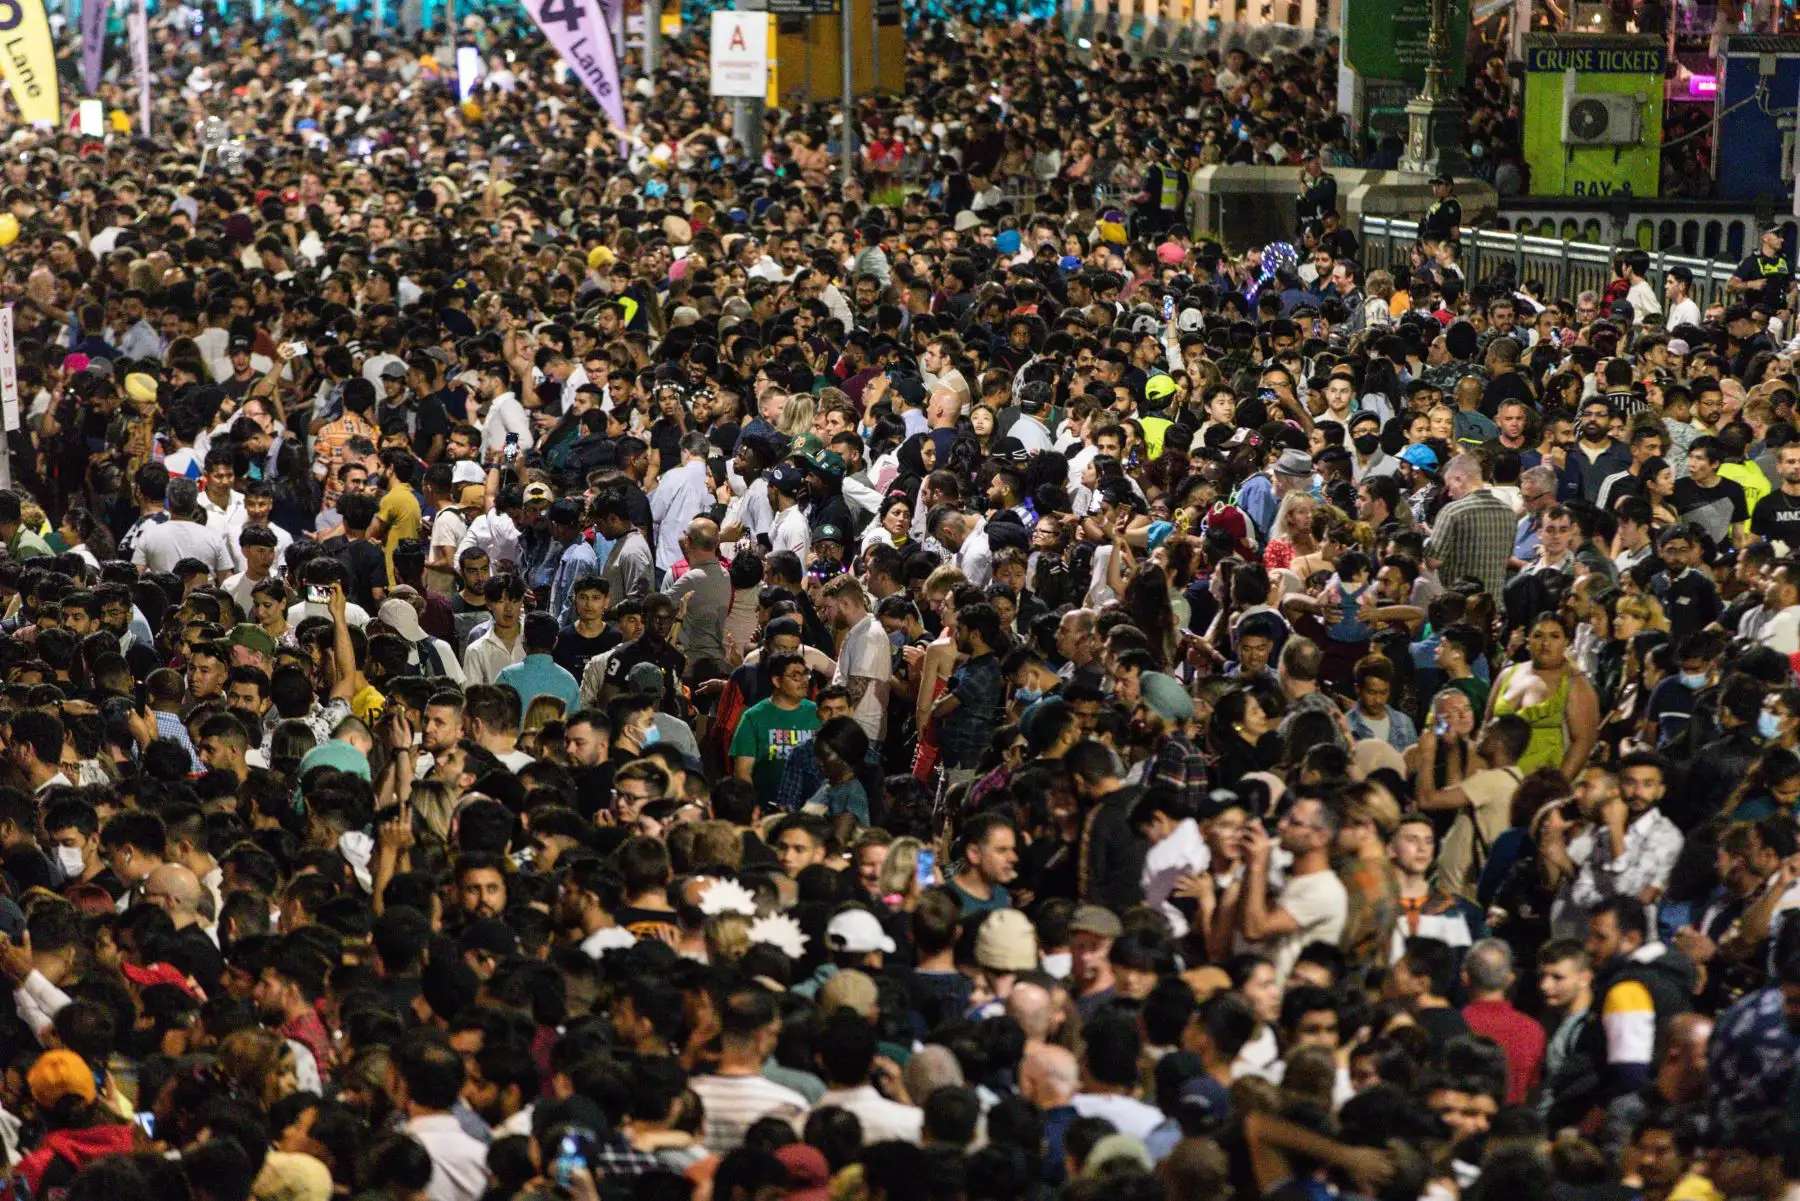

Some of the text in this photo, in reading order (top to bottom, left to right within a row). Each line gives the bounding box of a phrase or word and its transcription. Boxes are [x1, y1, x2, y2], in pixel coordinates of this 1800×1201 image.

[539, 0, 586, 32] 4
[729, 24, 747, 52] A
[5, 36, 42, 98] Lane
[569, 37, 613, 97] Lane
[1536, 49, 1660, 70] CRUISE TICKETS
[606, 657, 621, 676] 3
